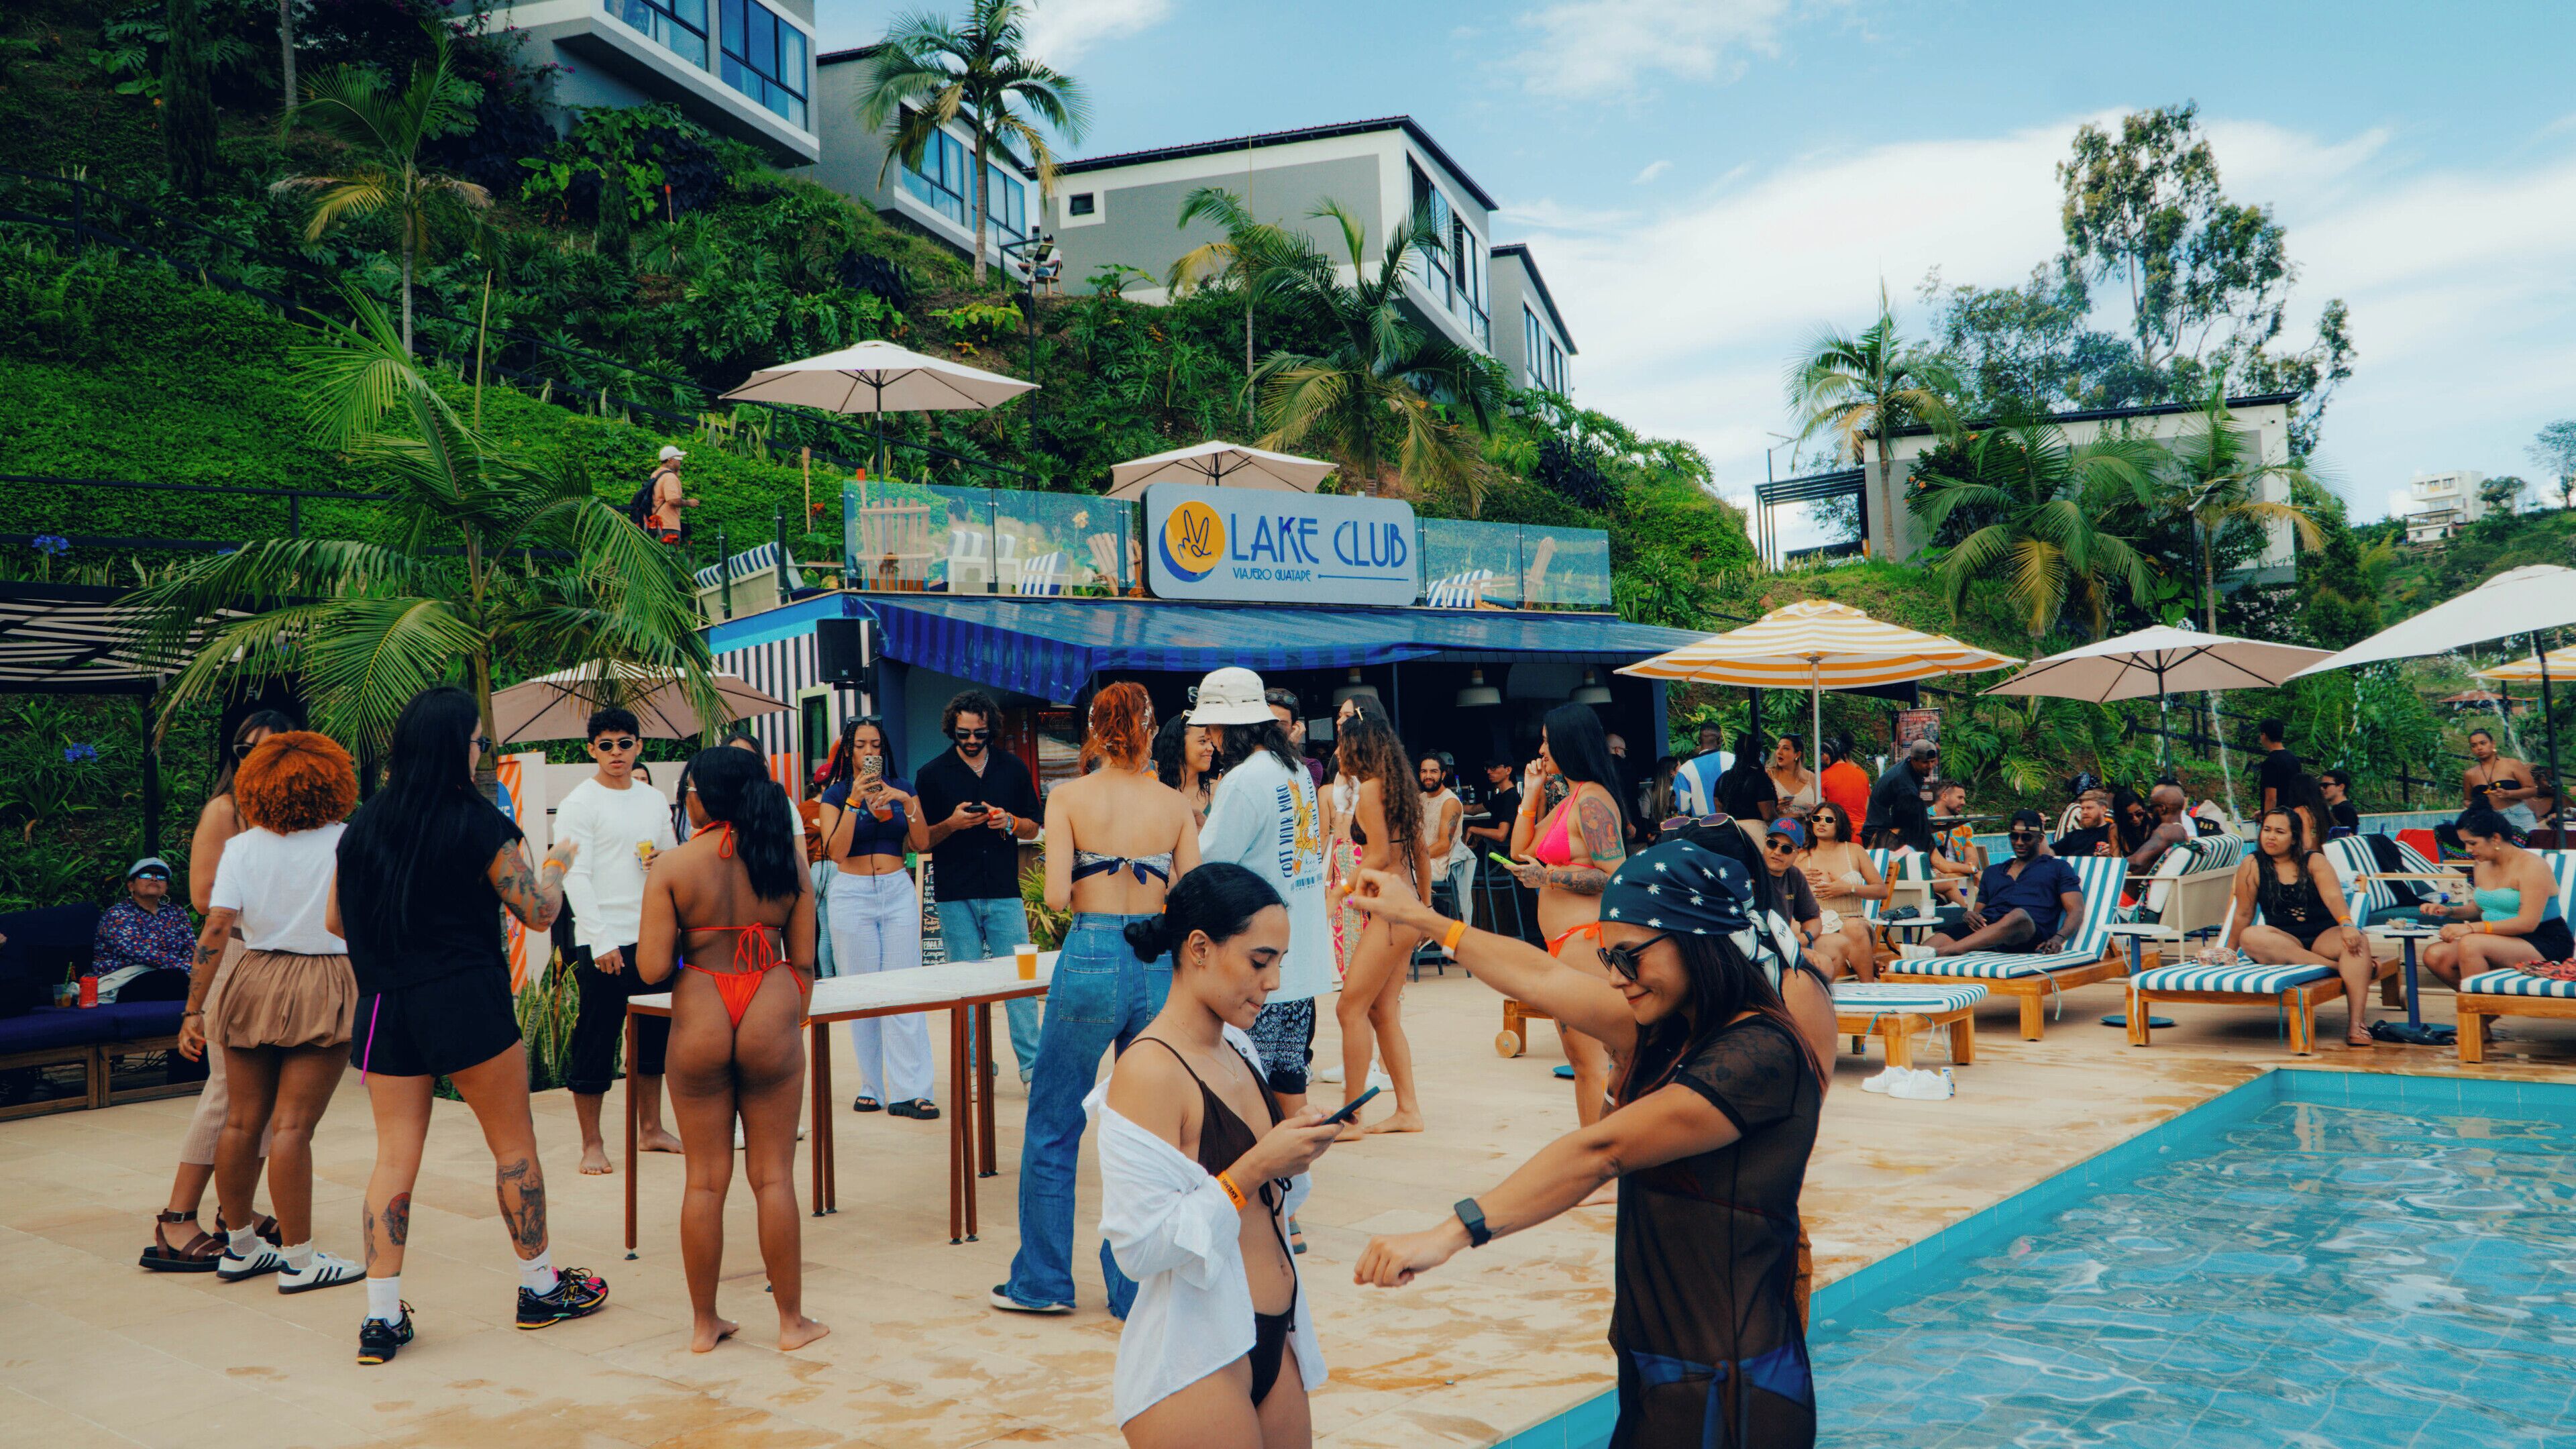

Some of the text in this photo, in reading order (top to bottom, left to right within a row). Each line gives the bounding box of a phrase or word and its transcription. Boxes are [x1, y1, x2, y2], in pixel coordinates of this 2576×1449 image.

[1231, 513, 1407, 568] LAKE CLUB
[1232, 567, 1272, 580] VIAJERO
[1276, 784, 1293, 812] MIND
[1279, 817, 1293, 845] YOUR
